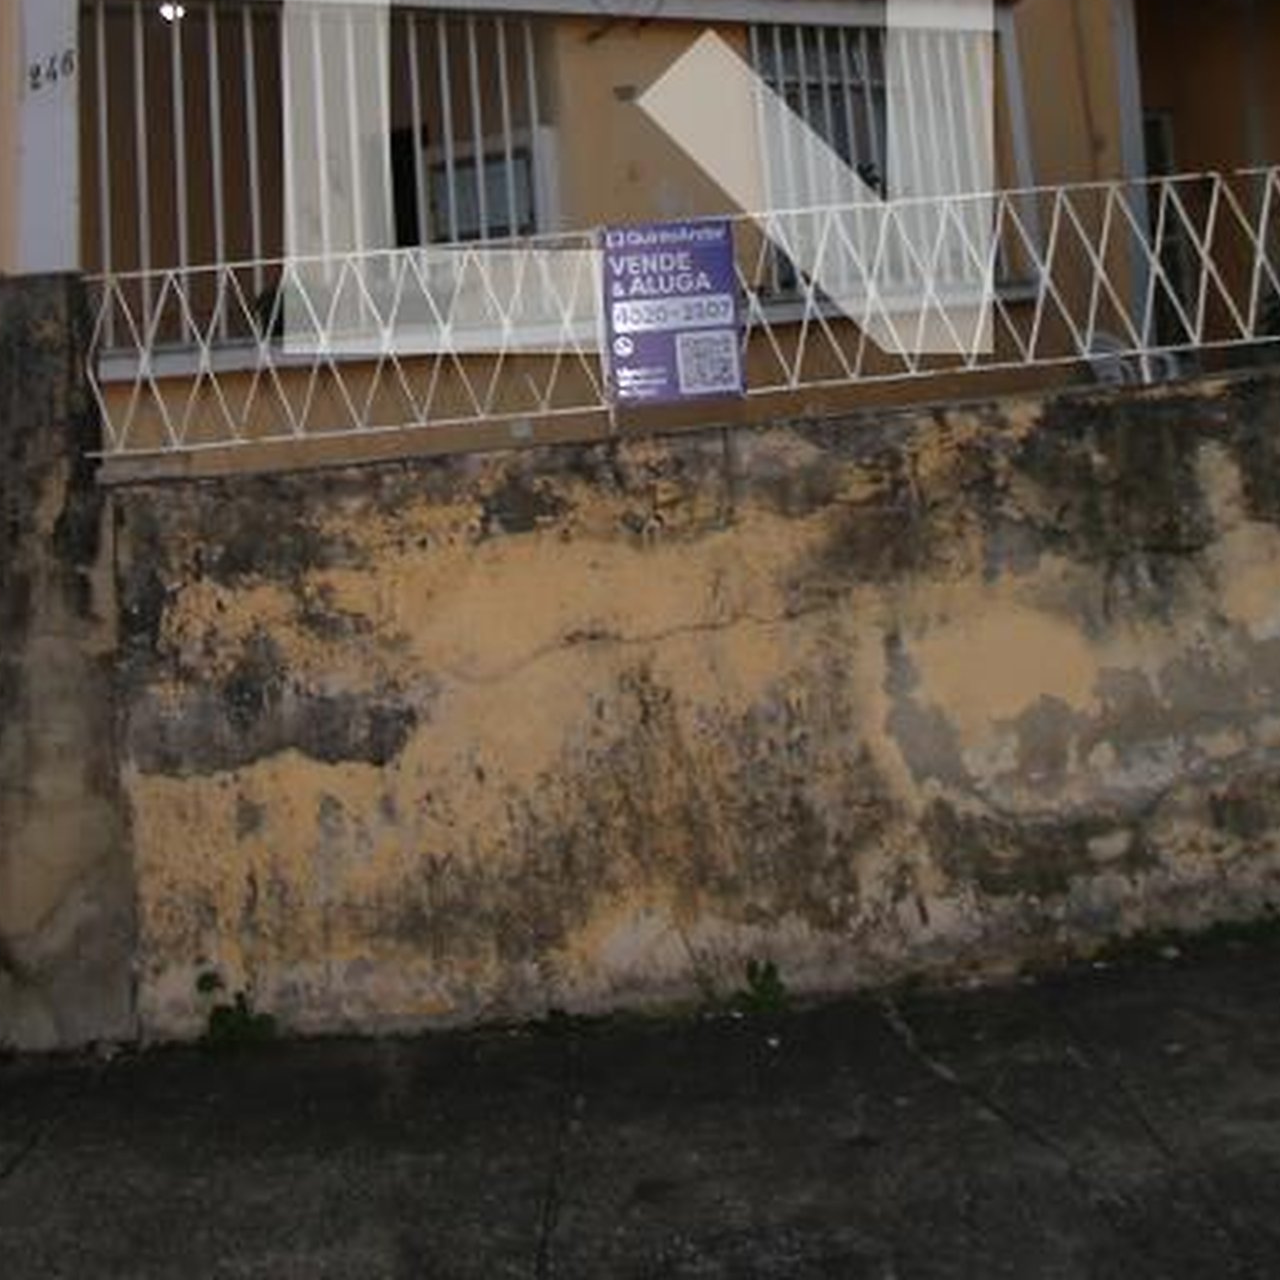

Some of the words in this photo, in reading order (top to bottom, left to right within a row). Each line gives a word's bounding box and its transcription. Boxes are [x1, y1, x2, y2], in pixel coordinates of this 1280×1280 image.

[29, 48, 75, 91] 246
[608, 252, 692, 276] VENDE
[629, 272, 712, 295] ALUGA
